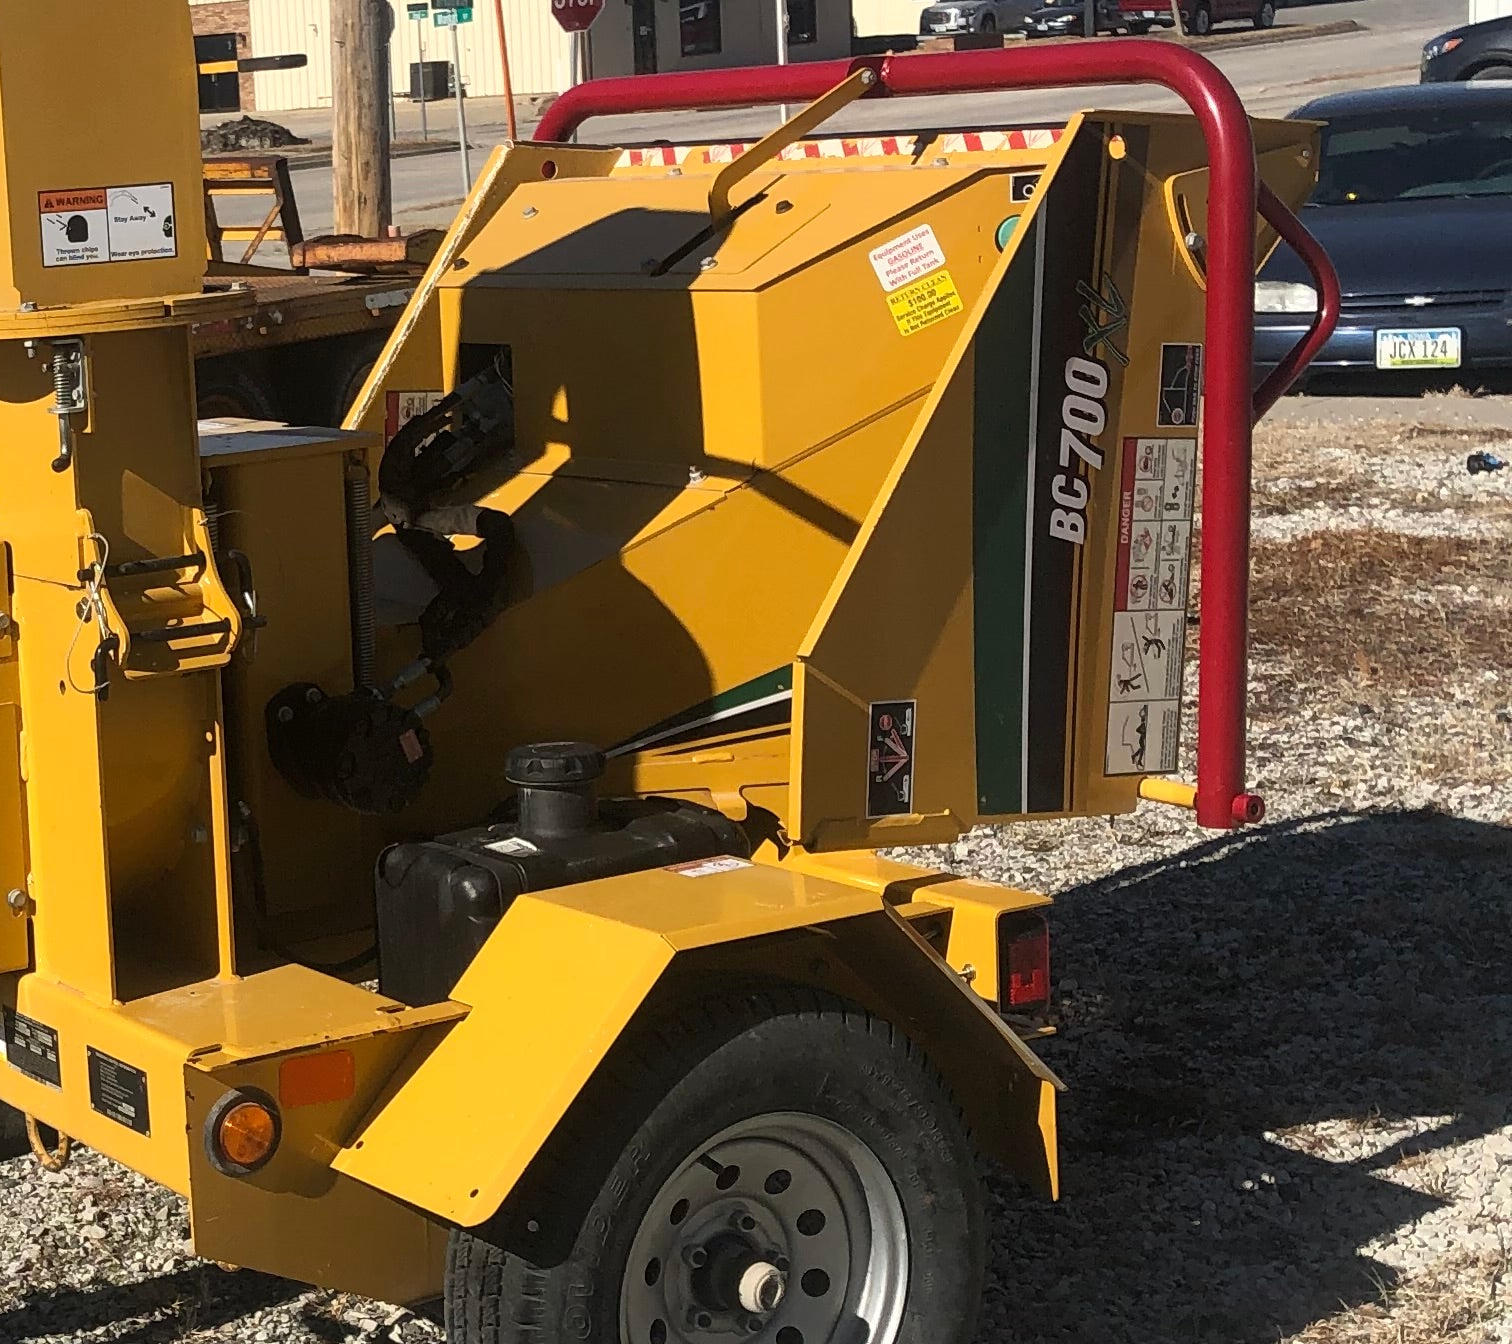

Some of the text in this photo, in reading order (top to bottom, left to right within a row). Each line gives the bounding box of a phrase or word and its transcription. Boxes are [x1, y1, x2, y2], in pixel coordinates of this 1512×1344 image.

[55, 195, 104, 206] WARNING
[129, 215, 146, 223] Away
[56, 246, 99, 255] Thrown chips
[129, 250, 140, 258] eye
[873, 230, 929, 261] Equipment Uses
[888, 243, 924, 266] GASOLINE
[886, 250, 934, 277] Please Return
[889, 258, 939, 286] With Full Tank
[891, 275, 946, 304] RETURN CLEAN
[908, 289, 936, 307] $100.00
[896, 309, 916, 321] Service
[1390, 340, 1448, 359] JCX 124
[1120, 491, 1132, 544] DANGER
